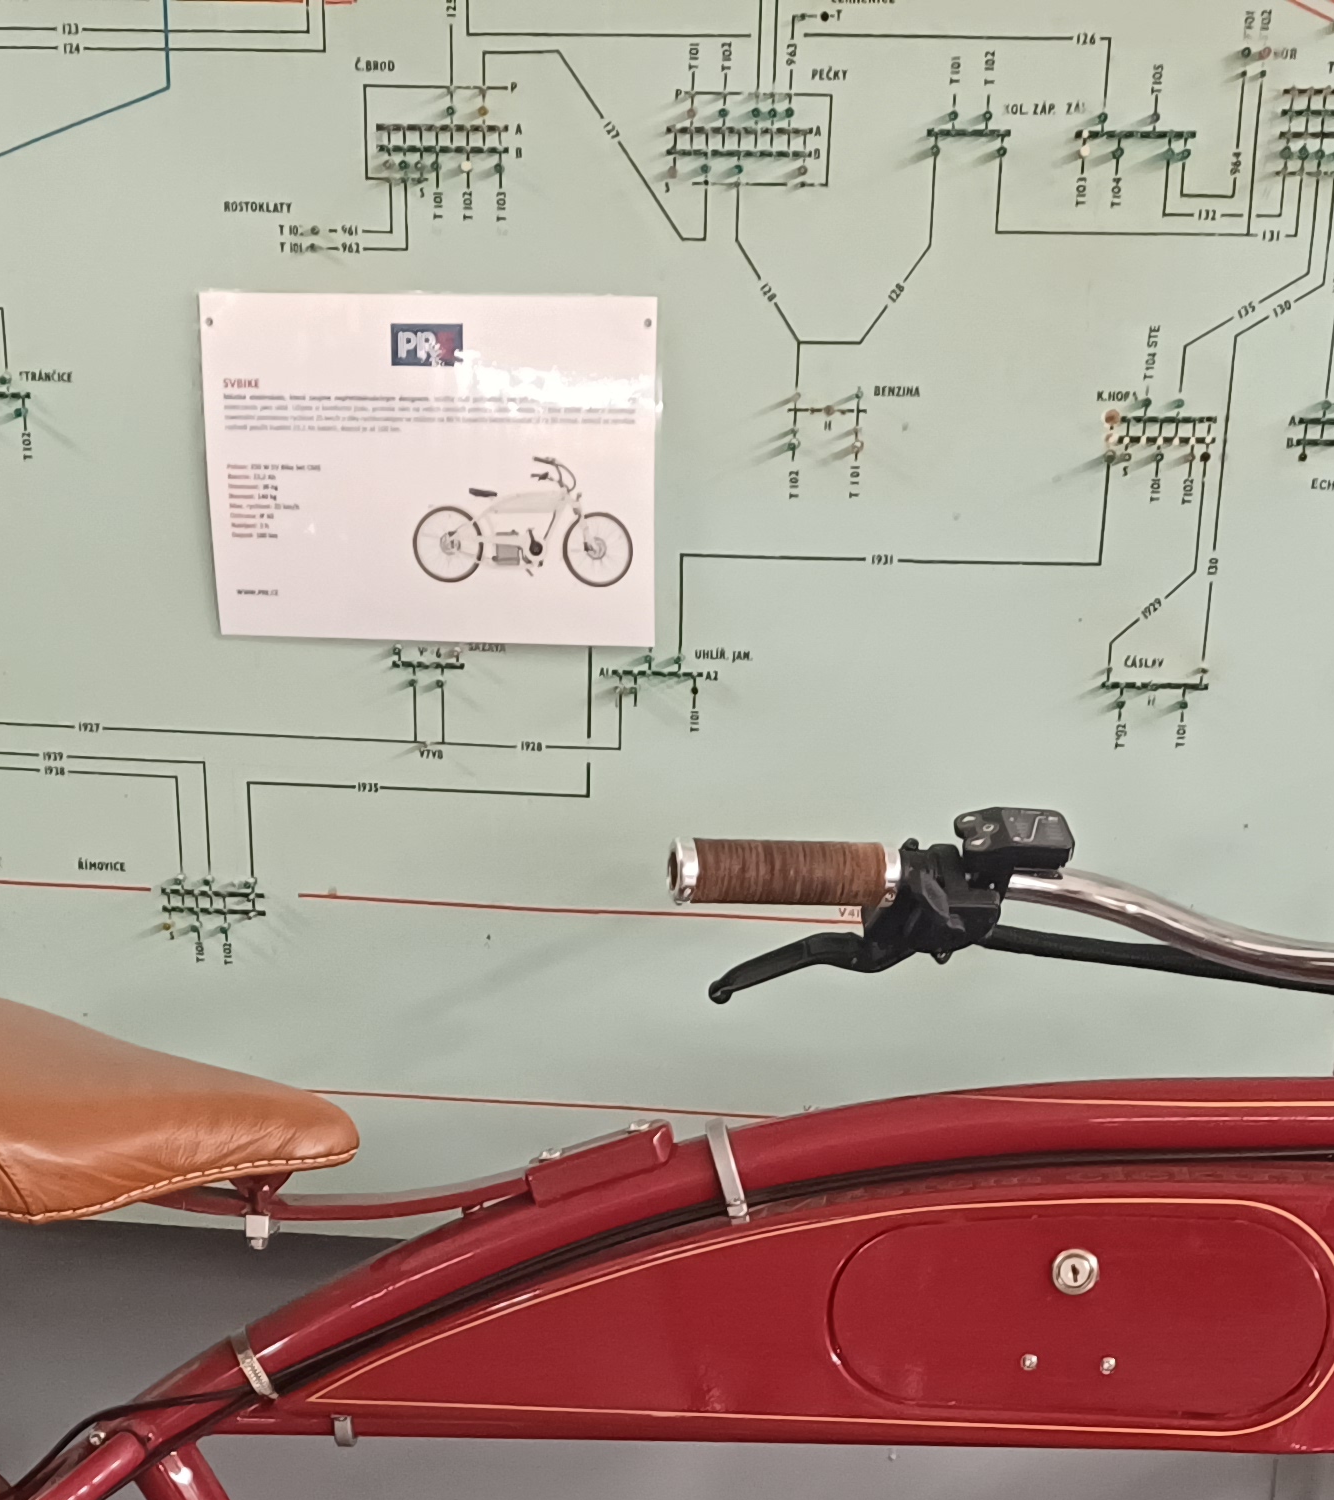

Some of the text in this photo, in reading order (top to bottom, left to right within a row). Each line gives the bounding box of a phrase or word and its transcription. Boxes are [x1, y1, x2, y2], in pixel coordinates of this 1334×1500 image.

[1076, 32, 1096, 45] 126
[811, 66, 848, 81] PEČKY
[223, 201, 292, 214] ROSTOKLATY
[1198, 209, 1216, 221] 132
[1262, 230, 1280, 241] 131
[1237, 301, 1256, 319] 135
[1272, 300, 1292, 318] 130
[223, 378, 259, 389] SVBIKE
[874, 386, 920, 398] BENZINA
[1207, 558, 1219, 576] 130
[78, 721, 100, 733] 1927
[43, 751, 63, 762] 1939
[44, 766, 65, 776] 1938
[358, 782, 379, 793] 1935
